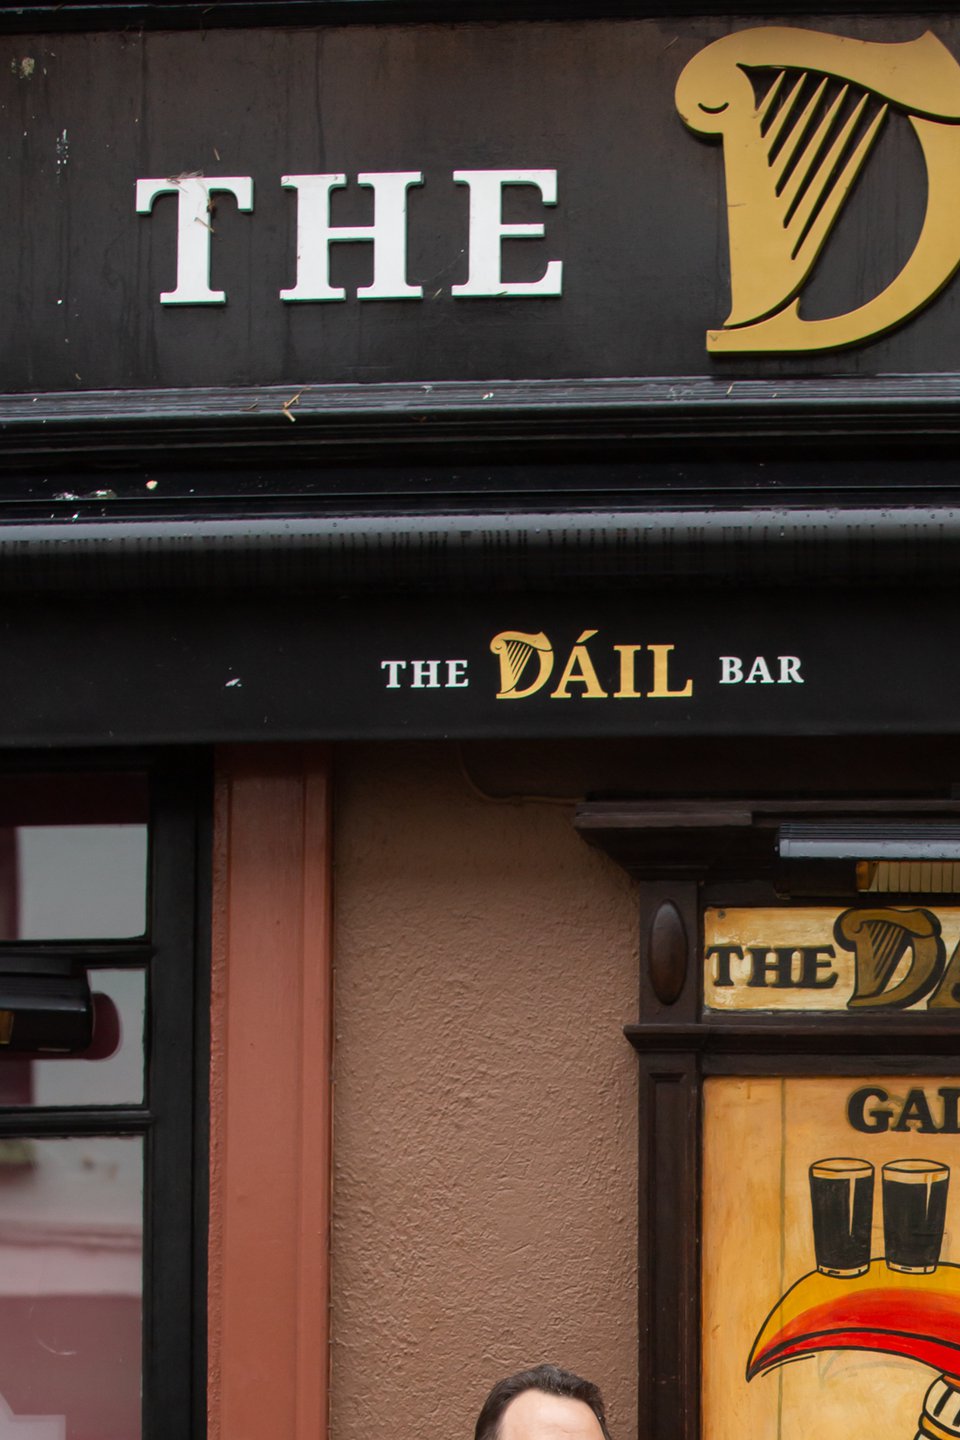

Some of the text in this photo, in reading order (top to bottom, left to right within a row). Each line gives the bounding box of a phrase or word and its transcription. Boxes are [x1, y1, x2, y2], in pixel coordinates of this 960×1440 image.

[136, 169, 562, 305] THE
[381, 630, 805, 699] THE DÁIL BAR
[705, 944, 838, 988] THE
